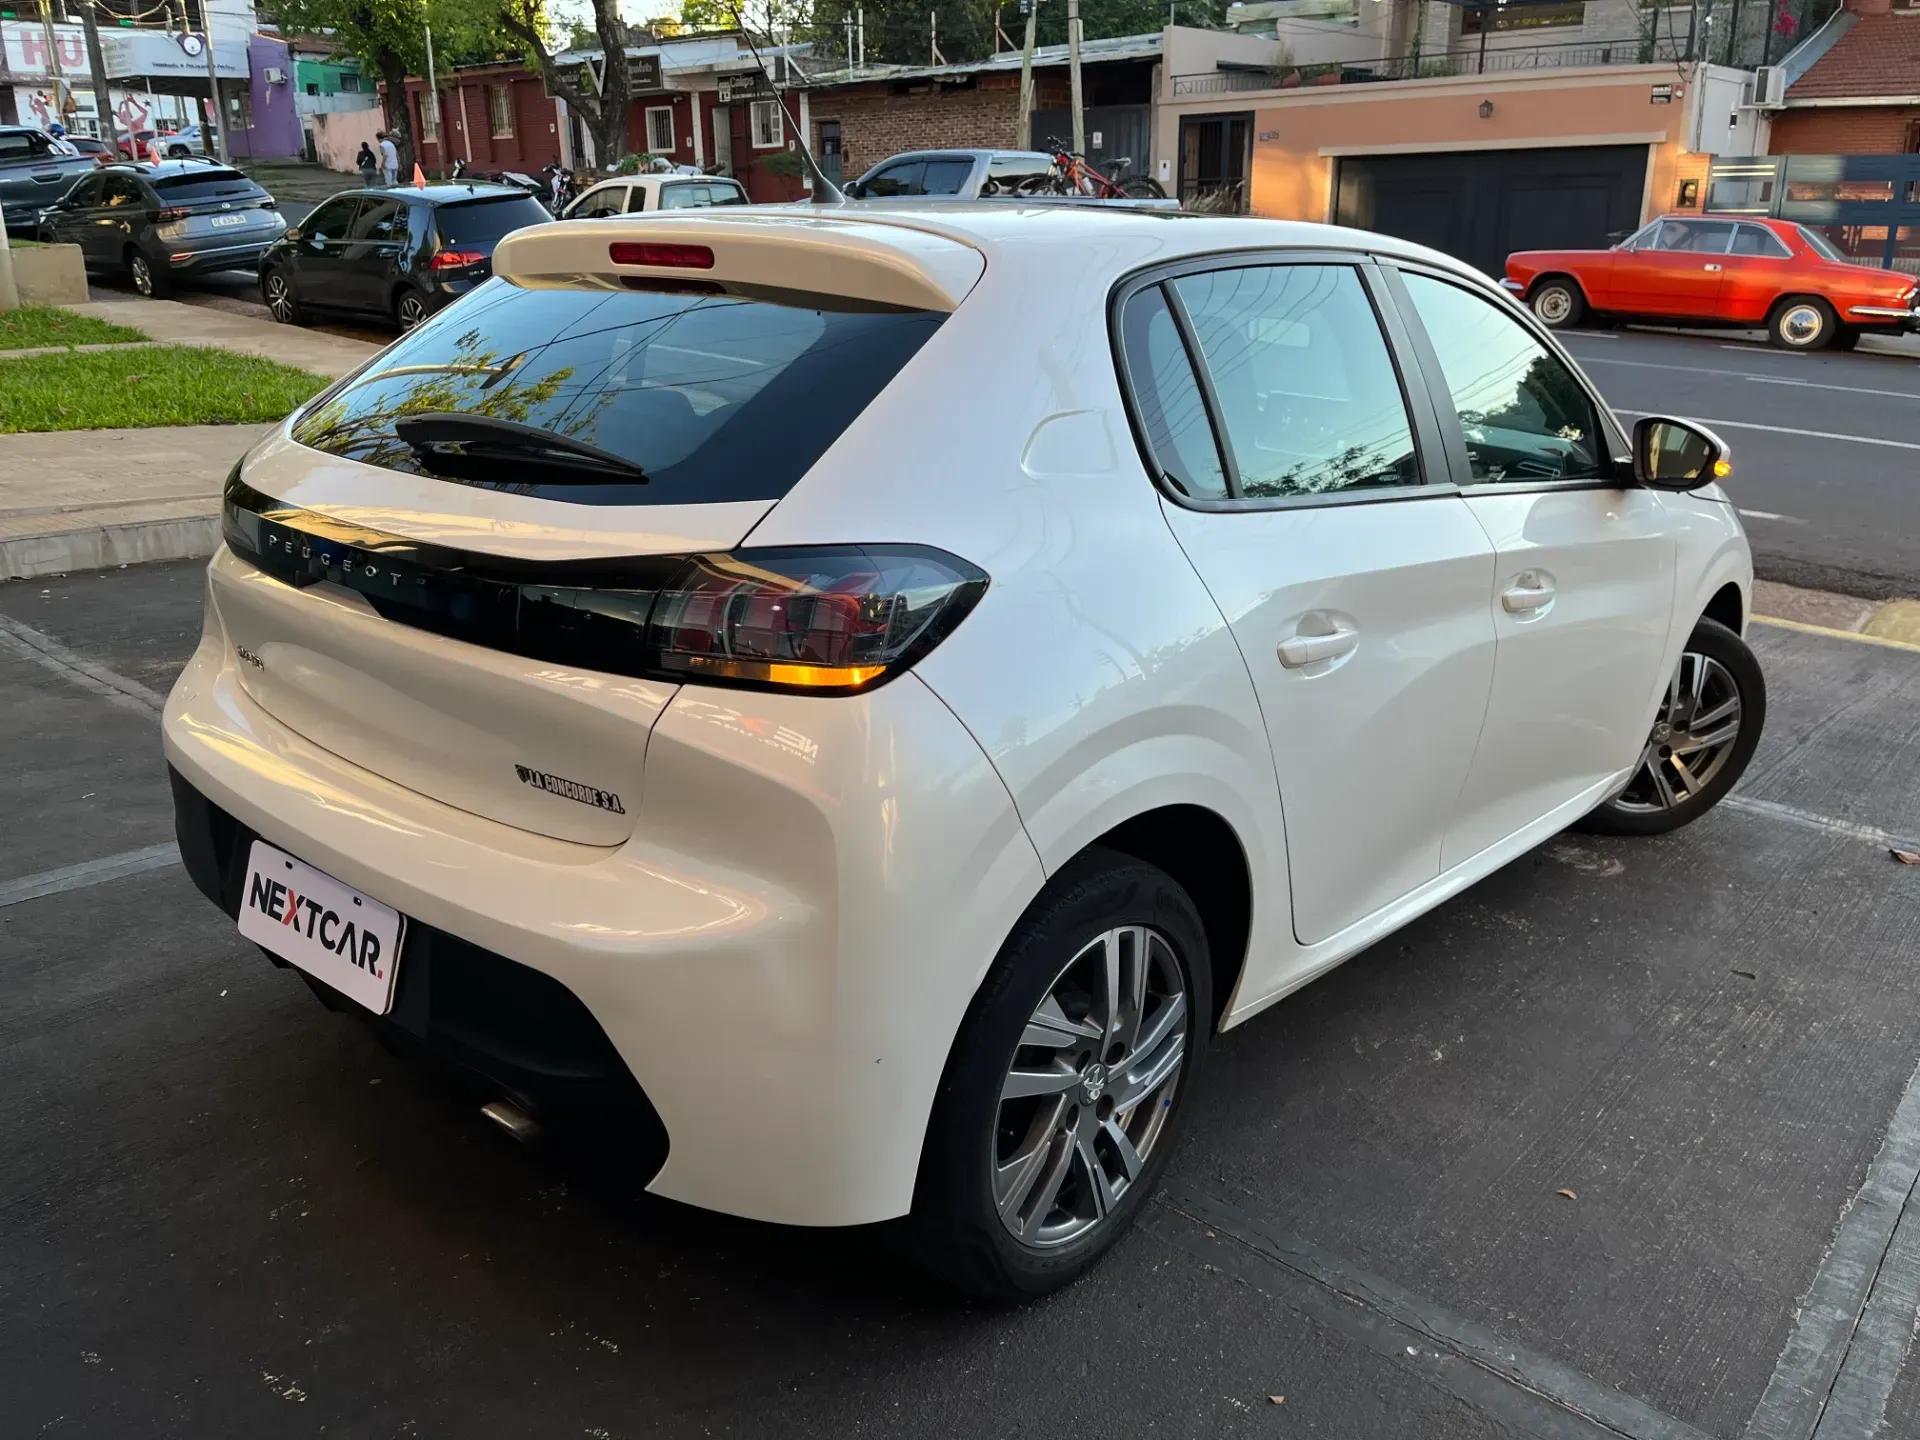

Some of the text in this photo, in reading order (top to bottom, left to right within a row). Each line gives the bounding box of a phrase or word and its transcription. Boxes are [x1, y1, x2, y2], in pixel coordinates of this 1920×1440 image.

[268, 534, 402, 586] PEUGEOT
[527, 768, 626, 814] LA CONCORDE S.A.
